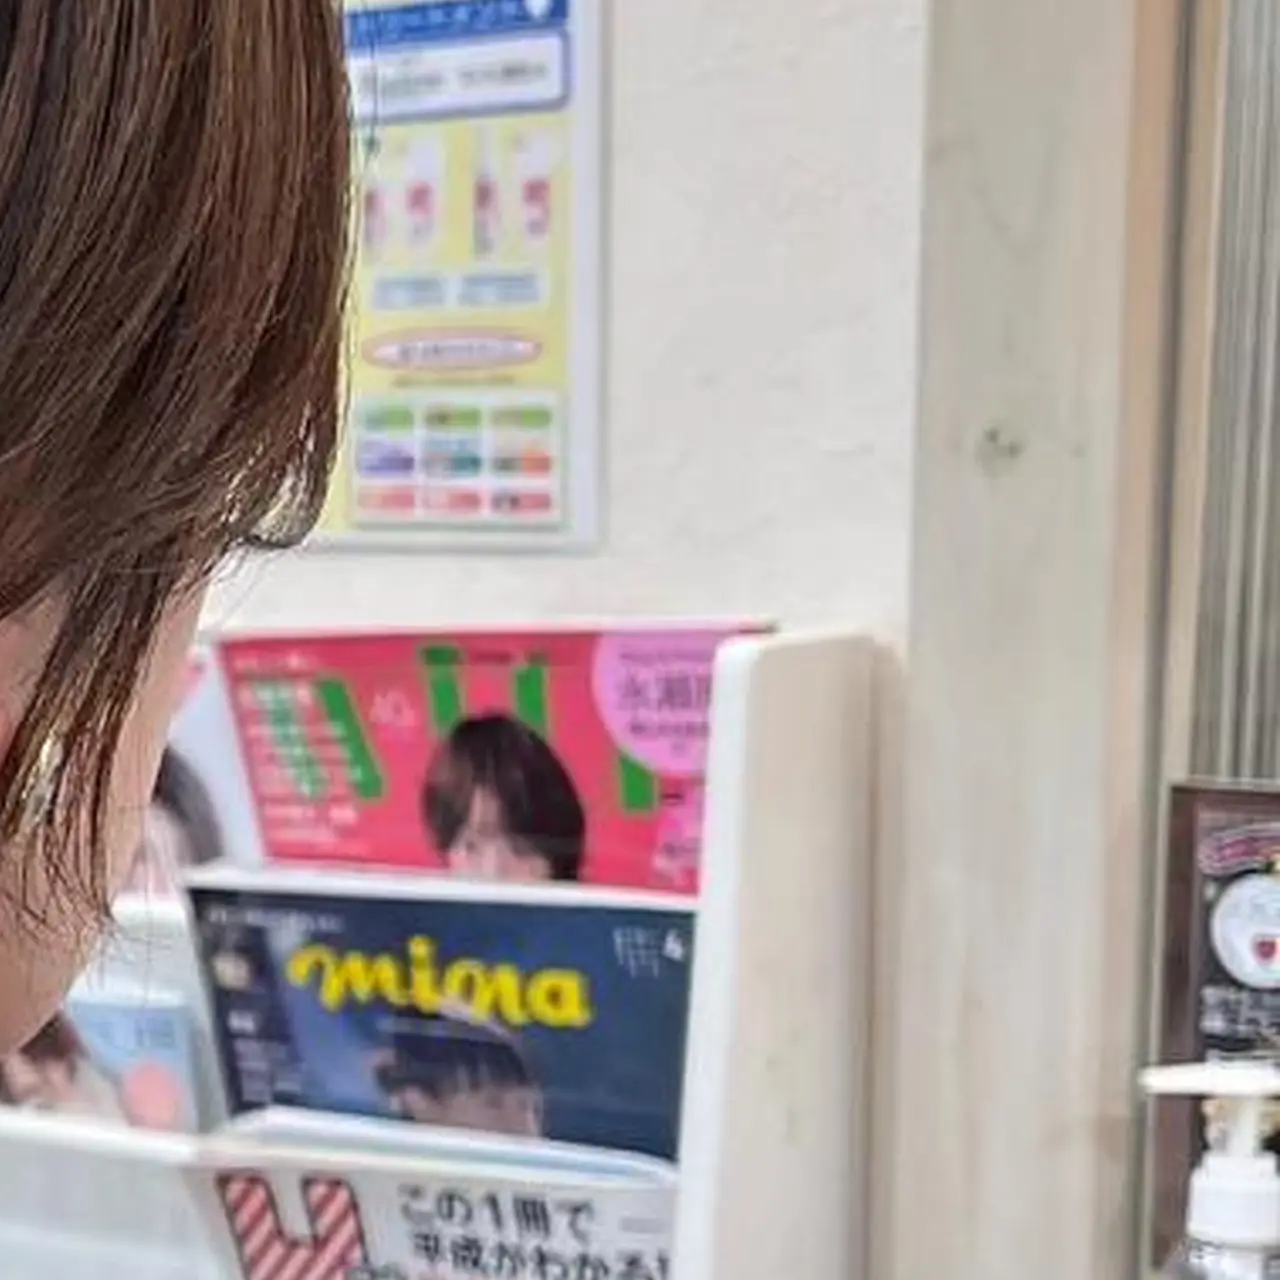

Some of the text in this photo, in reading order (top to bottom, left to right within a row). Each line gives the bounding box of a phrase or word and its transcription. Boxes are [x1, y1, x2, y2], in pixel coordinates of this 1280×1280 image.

[285, 933, 595, 1029] mina
[397, 1183, 597, 1244] この1冊で
